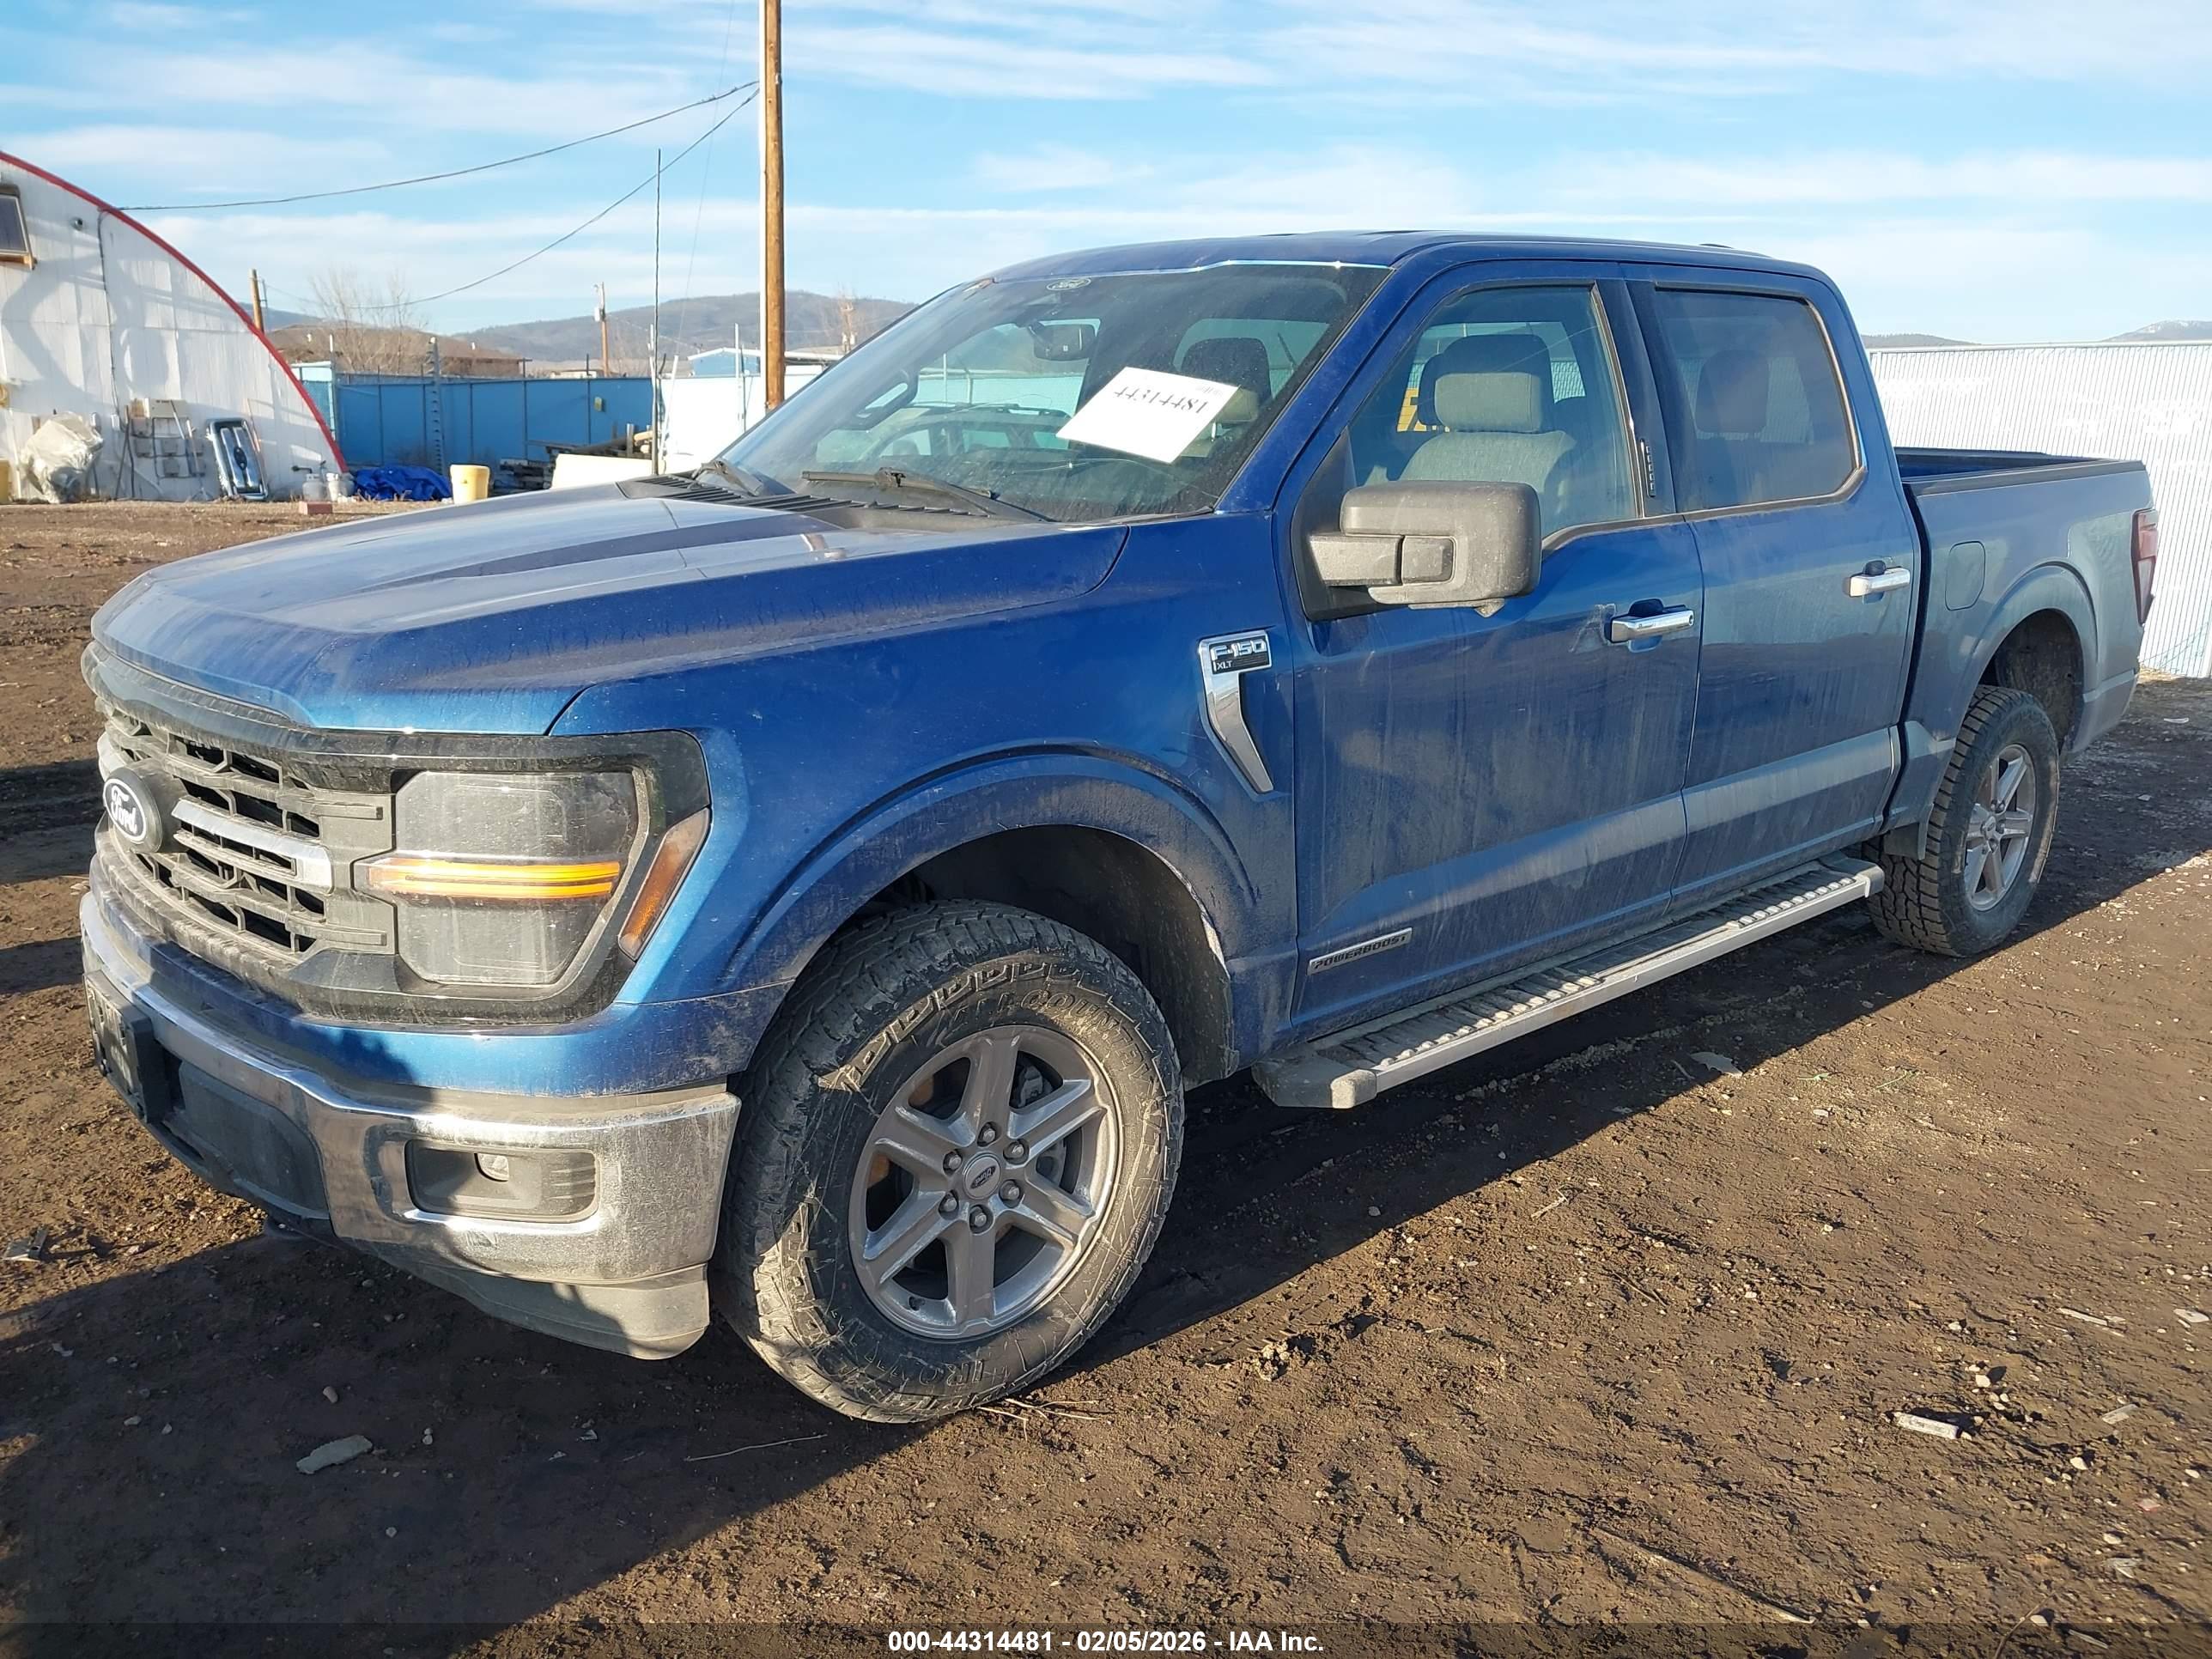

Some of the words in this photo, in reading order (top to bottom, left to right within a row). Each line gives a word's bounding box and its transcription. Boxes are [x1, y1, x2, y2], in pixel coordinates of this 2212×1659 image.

[1115, 386, 1209, 414] 44314481
[1210, 638, 1267, 661] F-150
[1217, 660, 1232, 671] XLT
[110, 784, 138, 836] Ford
[1315, 933, 1407, 969] POWERBOOST
